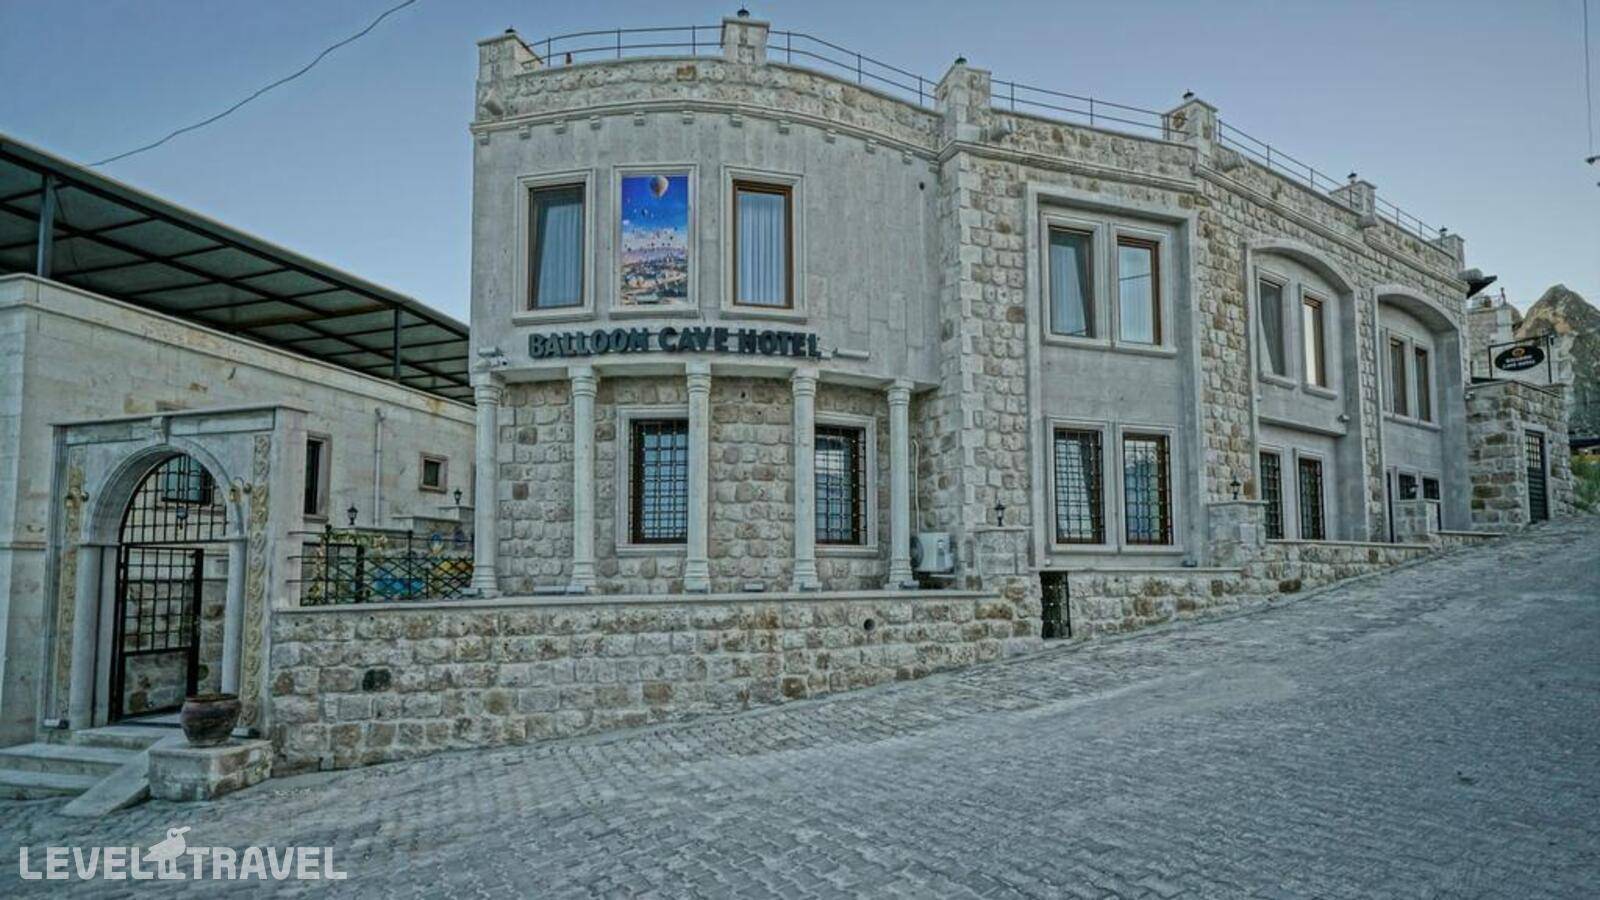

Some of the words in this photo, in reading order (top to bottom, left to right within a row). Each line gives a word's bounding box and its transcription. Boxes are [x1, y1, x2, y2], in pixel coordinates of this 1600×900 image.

[528, 328, 650, 359] BALLOON
[658, 326, 729, 352] CAVE
[737, 327, 821, 358] HOTEL
